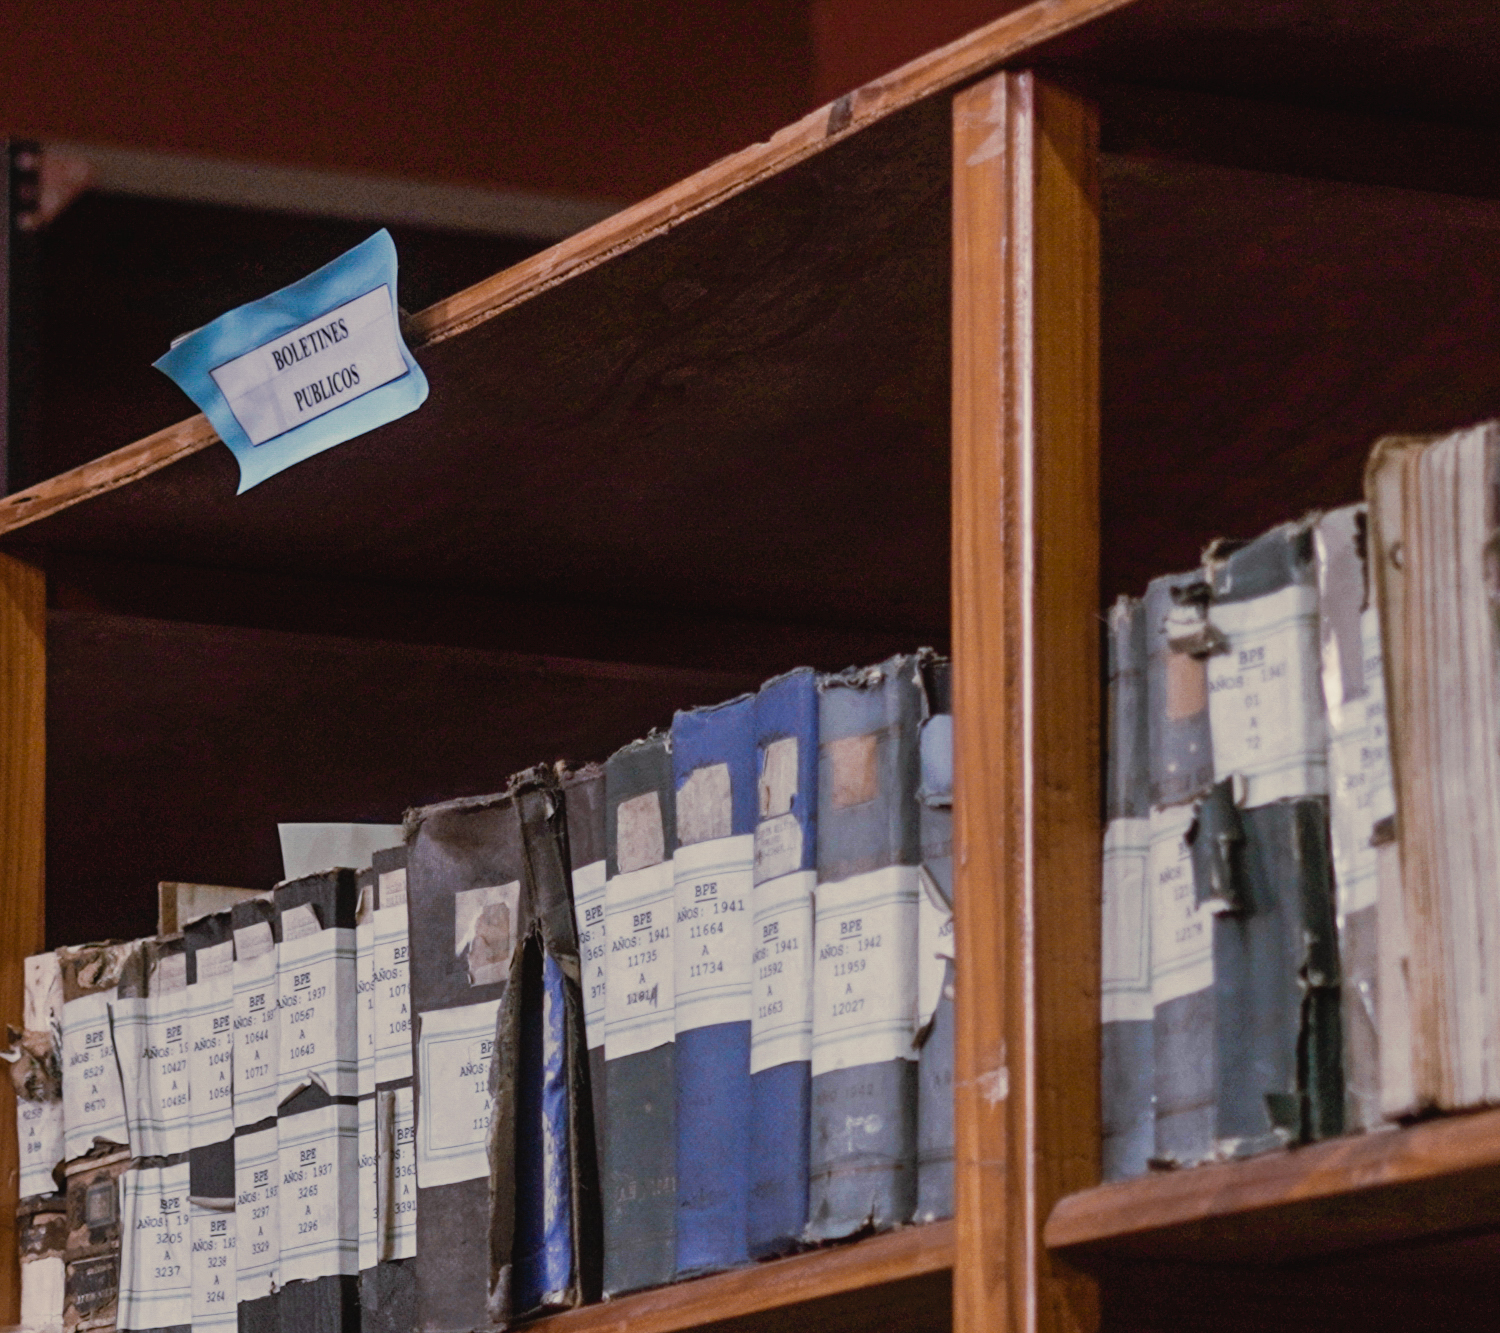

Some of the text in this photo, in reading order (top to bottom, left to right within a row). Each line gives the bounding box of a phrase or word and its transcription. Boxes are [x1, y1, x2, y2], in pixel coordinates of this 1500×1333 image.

[272, 317, 350, 372] BOLETINES
[293, 363, 361, 412] PUBLICOS
[694, 882, 717, 898] BPE
[585, 904, 603, 922] BPE
[676, 899, 745, 923] AÑOS: 1941
[633, 911, 652, 927] BPE
[690, 922, 724, 939] 11664
[763, 922, 779, 938] BPE
[840, 919, 862, 935] BPE
[611, 926, 670, 952] AÑOS: 1941
[775, 938, 798, 954] 1941
[701, 945, 710, 956] A
[819, 935, 882, 961] AÑOS: 1942
[628, 950, 657, 968] 11735
[597, 966, 603, 977] A
[690, 961, 723, 978] 11734
[759, 962, 783, 980] 11592
[833, 959, 867, 977] 11959
[294, 972, 311, 987] BPE
[638, 973, 646, 984] A
[767, 985, 773, 996] A
[845, 983, 852, 994] A
[249, 993, 266, 1008] BPE
[275, 986, 327, 1010] AÑOS: 1937
[400, 1003, 408, 1014] A
[758, 1001, 783, 1019] 11663
[832, 998, 865, 1017] 12027
[213, 1015, 230, 1030] BPE
[233, 1016, 257, 1030] AÑOS:
[290, 1008, 315, 1024] 10567
[85, 1030, 104, 1045] BPE
[166, 1025, 182, 1040] BPE
[244, 1029, 269, 1045] 10644
[299, 1029, 306, 1039] A
[194, 1038, 221, 1051] AÑOS:
[290, 1043, 315, 1060] 10643
[254, 1050, 260, 1060] A
[83, 1066, 104, 1079] 8529
[161, 1060, 187, 1075] 10427
[244, 1065, 269, 1080] 10717
[459, 1062, 488, 1077] AÑOS:
[218, 1071, 225, 1081] A
[91, 1085, 98, 1094] A
[172, 1081, 178, 1090] A
[84, 1099, 106, 1112] 8670
[484, 1099, 491, 1110] A
[300, 1148, 317, 1162] BPE
[253, 1169, 269, 1184] BPE
[283, 1163, 333, 1184] AÑOS: 1937
[298, 1184, 318, 1199] 3265
[403, 1184, 410, 1195] A
[159, 1197, 180, 1211] BPE
[236, 1190, 261, 1206] AÑOS:
[252, 1205, 270, 1220] 3297
[305, 1205, 312, 1215] A
[394, 1200, 416, 1214] 3391
[137, 1217, 167, 1230] AÑOS:
[210, 1220, 227, 1233] BPE
[258, 1226, 264, 1236] A
[298, 1219, 318, 1235] 3296
[155, 1233, 183, 1245] 3205
[192, 1239, 217, 1253] AÑOS:
[252, 1240, 270, 1255] 3329
[163, 1251, 171, 1261] A
[207, 1256, 227, 1268] 3238
[155, 1266, 181, 1278] 3237
[213, 1275, 220, 1286] A
[206, 1291, 225, 1304] 3264
